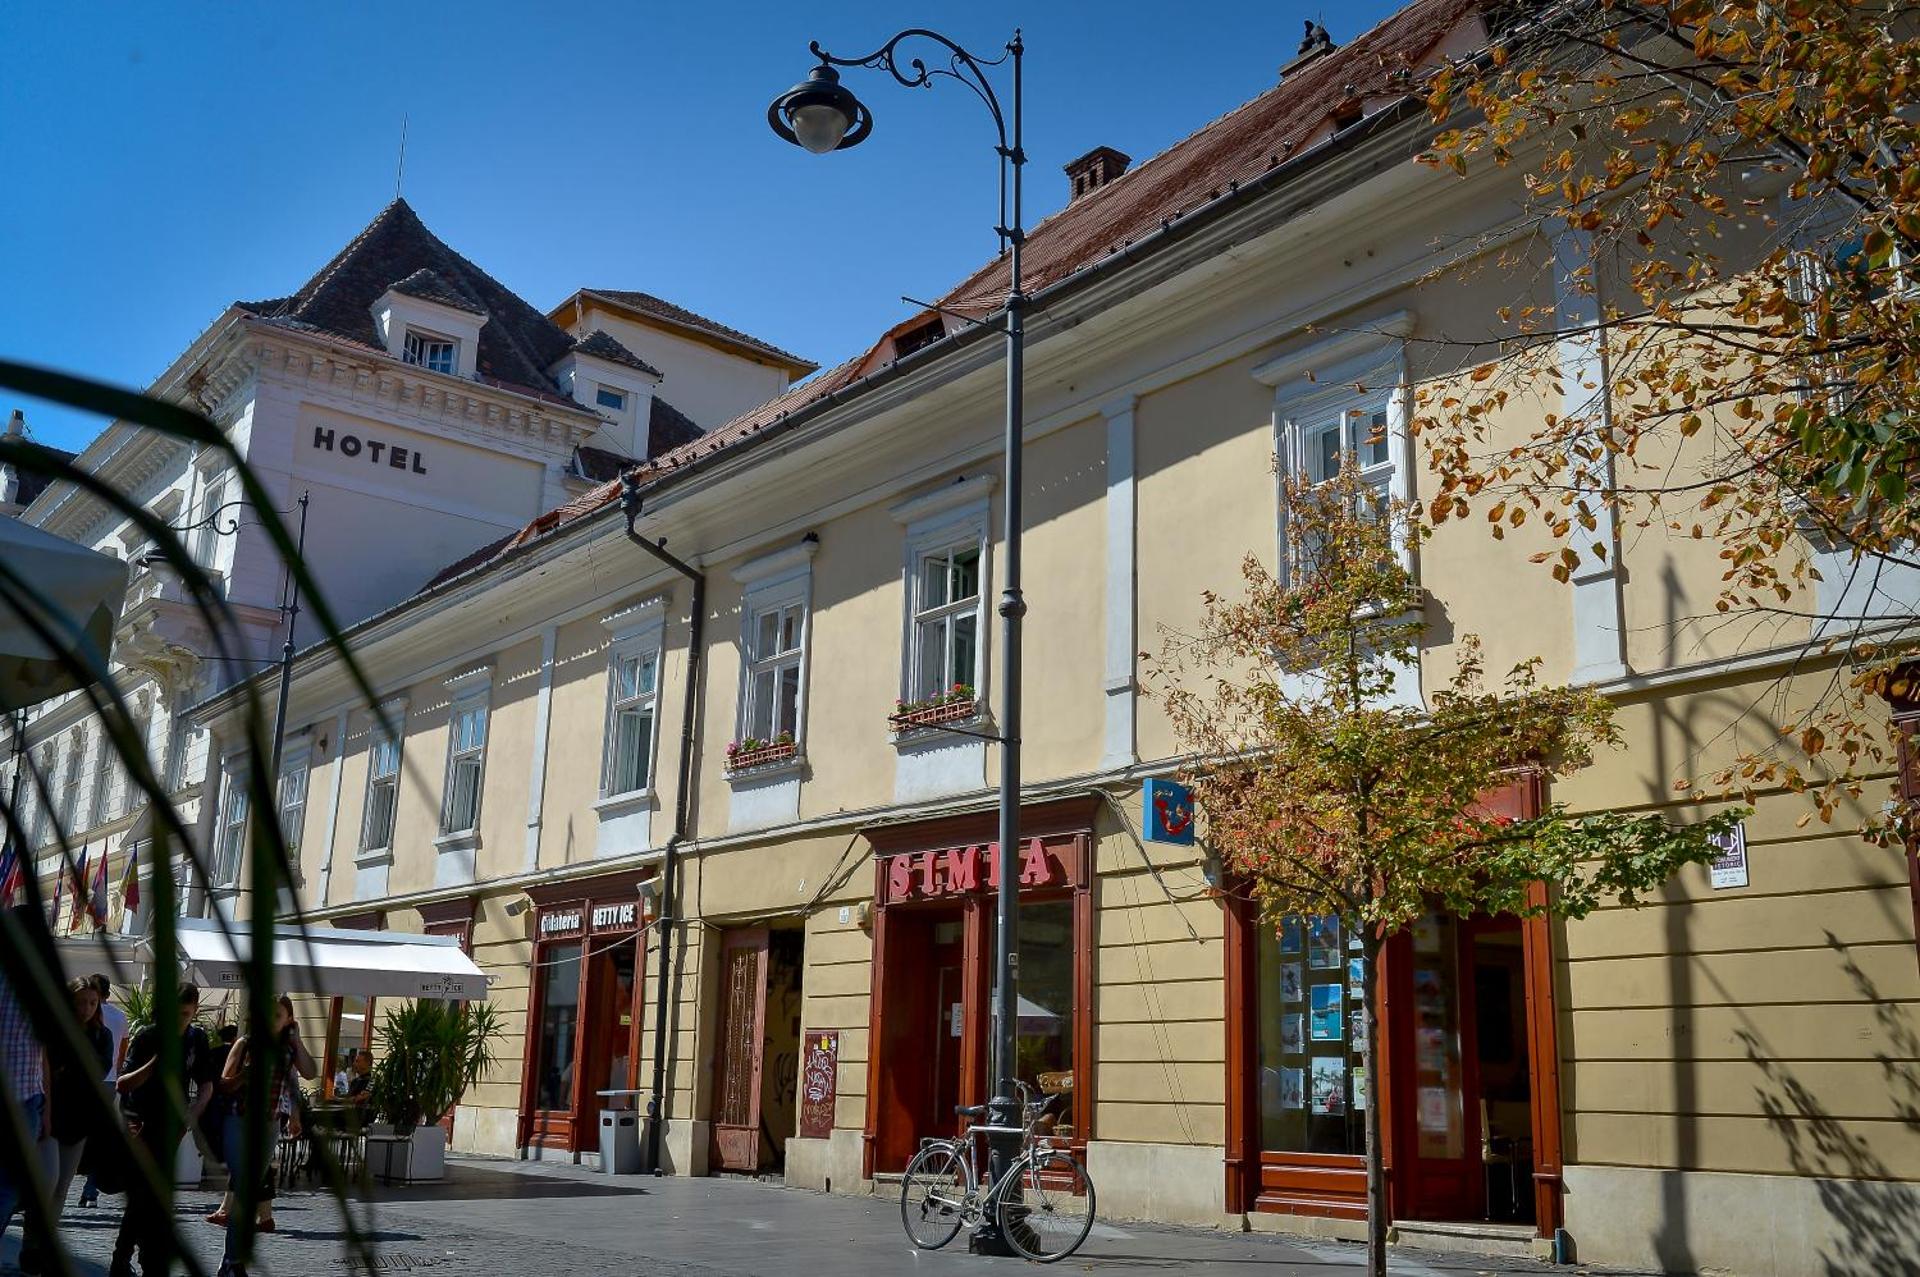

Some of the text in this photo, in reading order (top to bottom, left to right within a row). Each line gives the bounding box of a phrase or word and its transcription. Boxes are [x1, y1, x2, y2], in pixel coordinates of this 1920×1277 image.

[313, 426, 427, 475] HOTEL
[593, 906, 619, 926] BETTY
[619, 905, 634, 923] ICE
